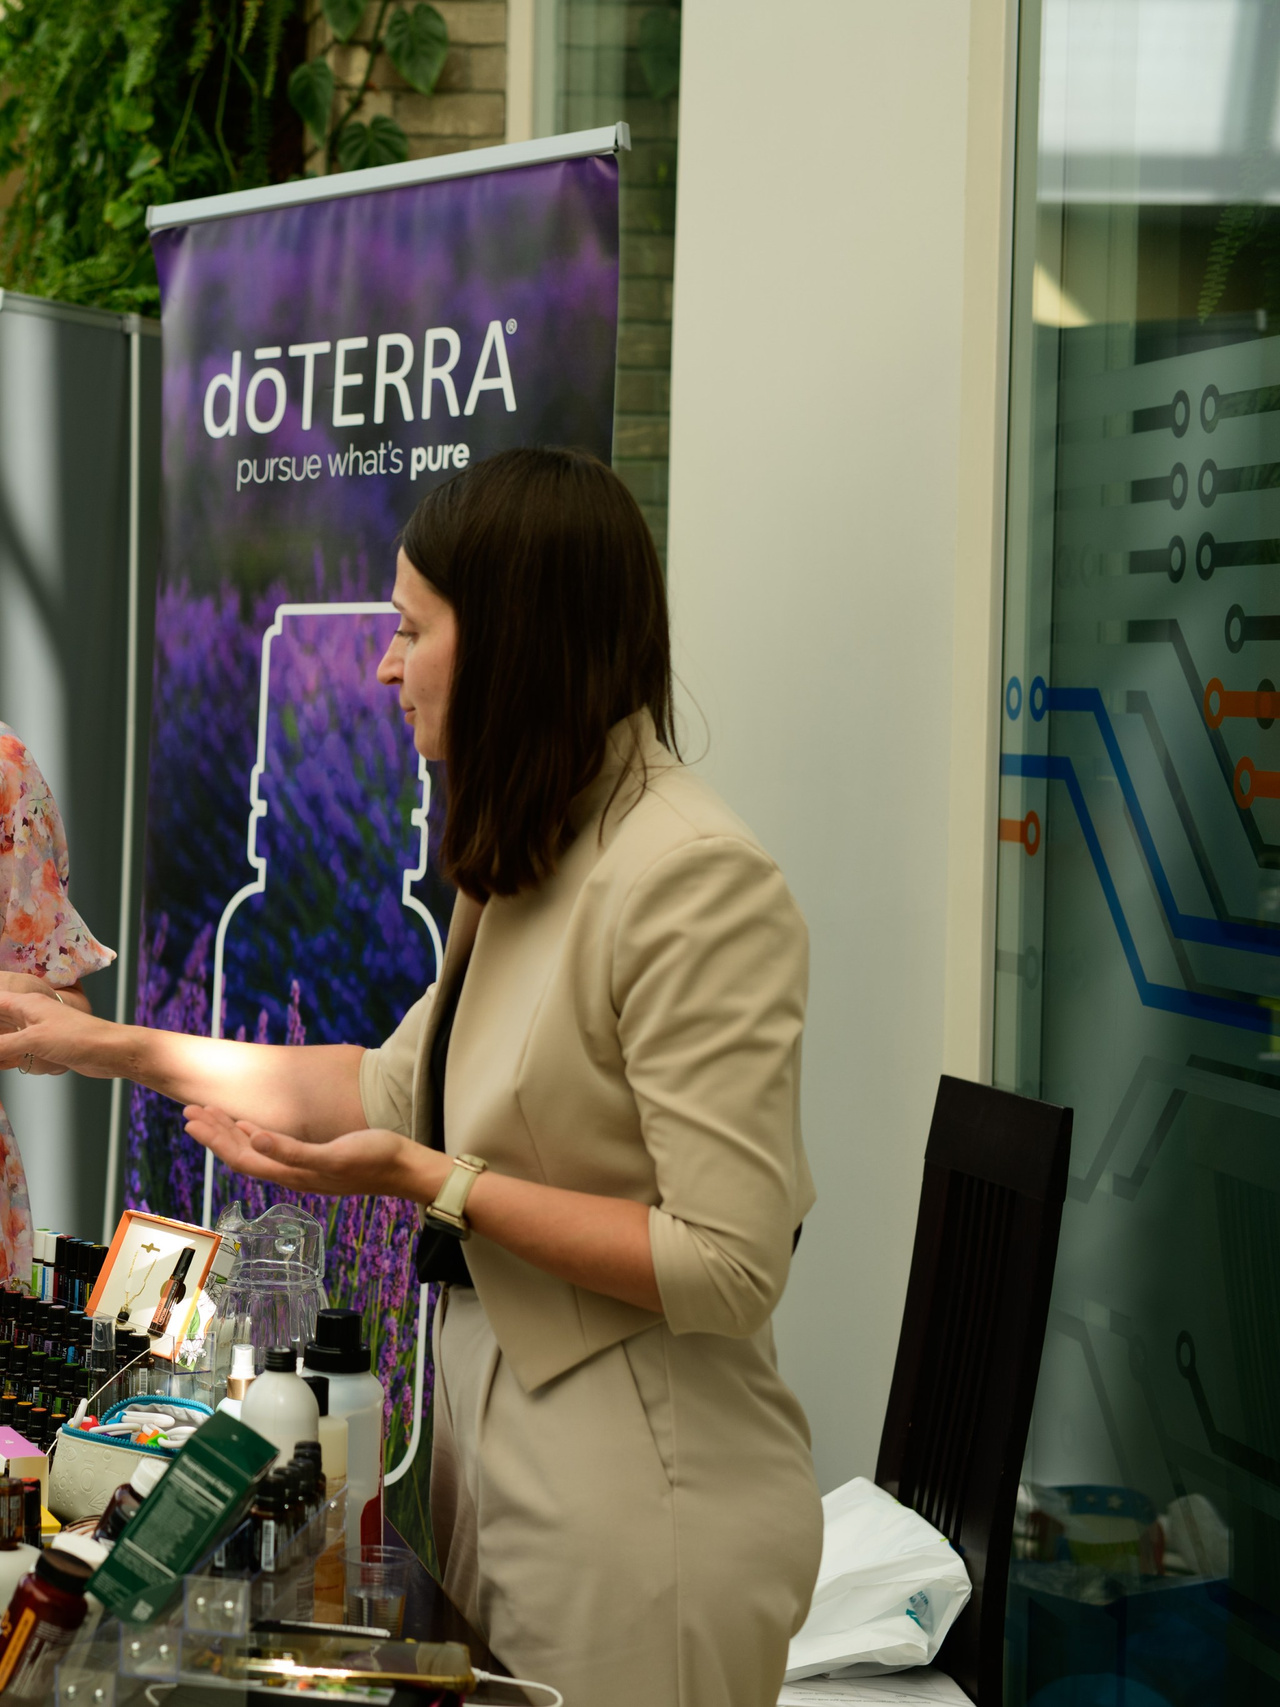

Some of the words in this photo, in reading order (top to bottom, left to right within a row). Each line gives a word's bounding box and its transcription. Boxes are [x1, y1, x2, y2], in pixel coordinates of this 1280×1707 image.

[236, 454, 322, 492] pursue
[327, 440, 403, 478] what's
[410, 442, 470, 481] pure
